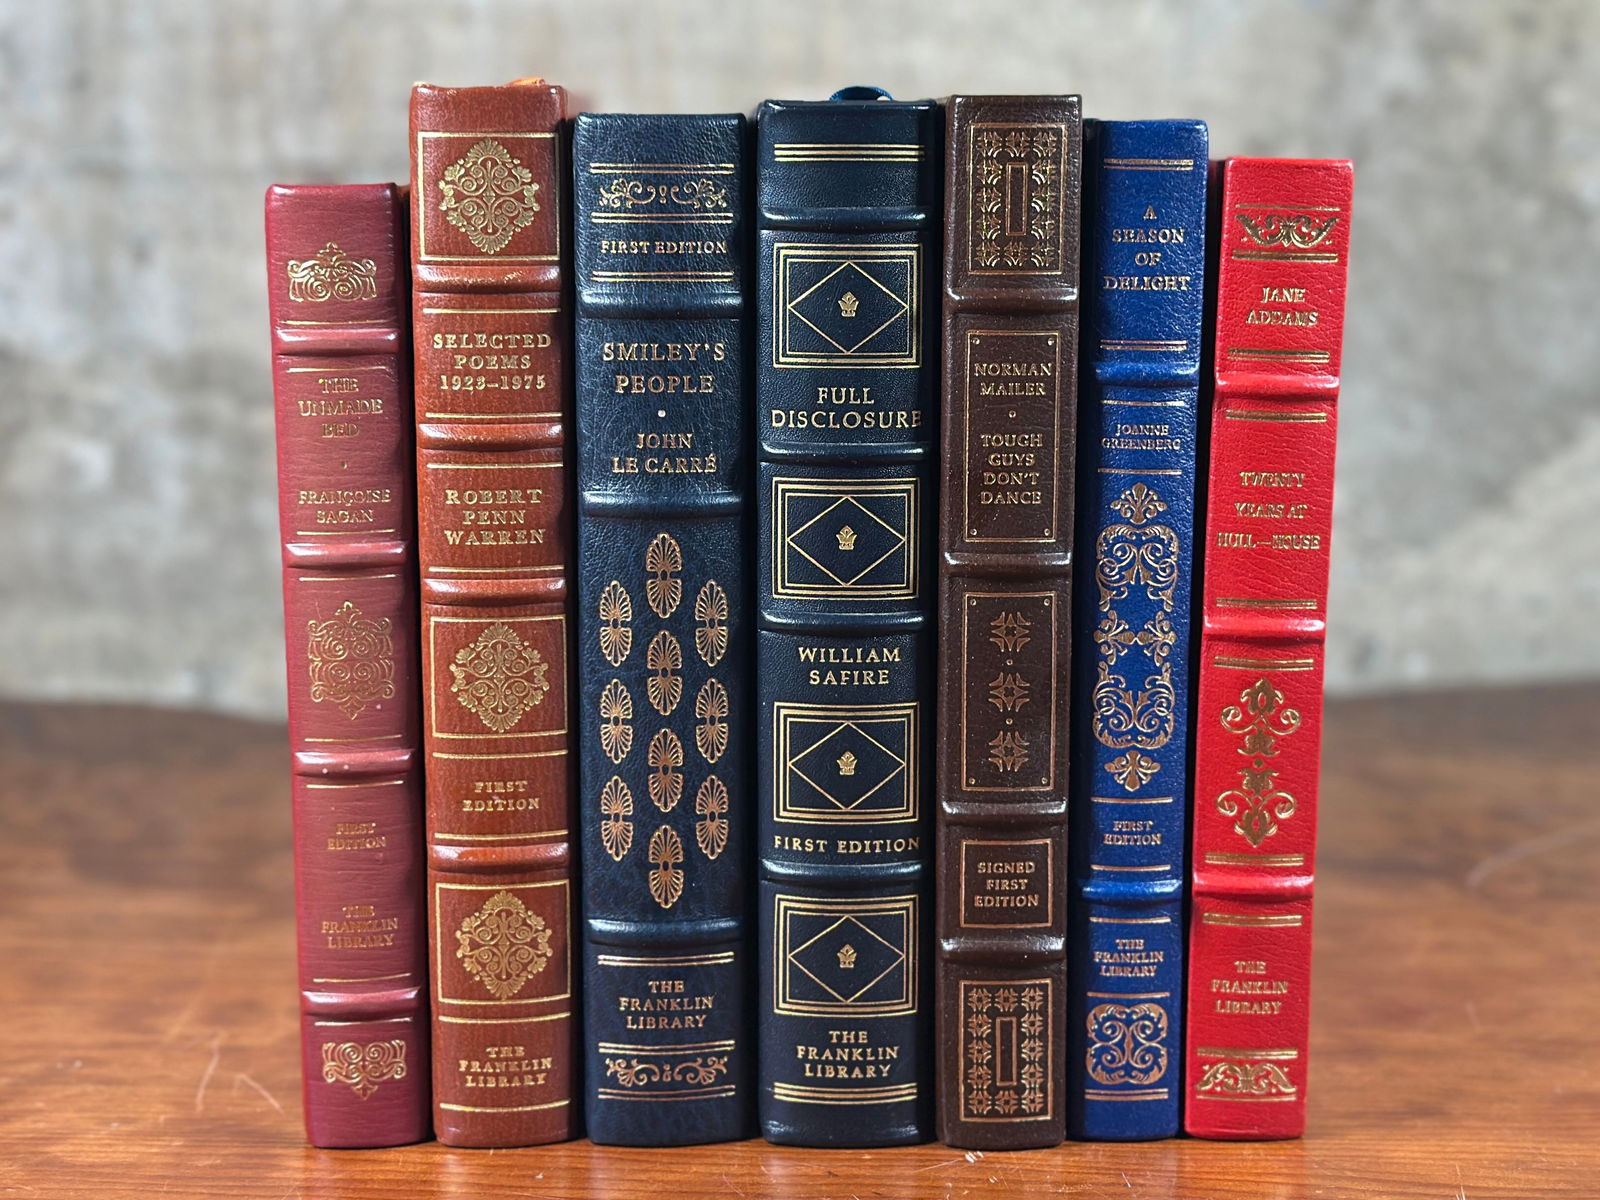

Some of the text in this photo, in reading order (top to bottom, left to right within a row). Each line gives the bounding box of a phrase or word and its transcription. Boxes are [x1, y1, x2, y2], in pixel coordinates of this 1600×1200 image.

[1143, 205, 1158, 220] A
[1111, 228, 1185, 244] SEASON
[600, 240, 727, 254] FIRST EDITION
[1135, 252, 1162, 266] OF
[1103, 276, 1191, 291] DELIGHT
[1260, 287, 1306, 303] JANE
[1245, 309, 1319, 327] ADDAMS
[433, 333, 551, 349] SELECTED
[602, 342, 726, 361] SMILEY'S
[454, 355, 532, 370] POEMS
[974, 363, 1052, 376] NORMAN
[318, 377, 359, 394] THE
[615, 375, 715, 394] PEOPLE
[980, 383, 1046, 396] MAILER
[816, 387, 875, 404] FULL
[298, 398, 384, 416] UNMADE
[771, 409, 922, 428] DISCLOSURE
[321, 422, 360, 438] BED
[1115, 424, 1169, 436] JOANNE
[636, 433, 693, 449] JOHN
[980, 434, 1043, 447] TOUGH
[1101, 438, 1182, 450] GREENBERG
[611, 453, 718, 474] LE CARRÉ
[988, 453, 1036, 466] GUYS
[983, 472, 1040, 485] DON'T
[1239, 471, 1306, 488] TWENTY
[298, 489, 392, 506] FRANÇOISE
[445, 489, 543, 505] ROBERT
[980, 491, 1042, 504] DANCE
[316, 509, 374, 524] SAGAN
[462, 510, 526, 525] PENN
[1234, 502, 1308, 519] YEARS AT
[444, 529, 546, 545] WARREN
[798, 646, 901, 663] WILLIAM
[809, 670, 889, 685] SAFIRE
[474, 780, 528, 793] FIRST
[462, 798, 540, 812] EDITION
[336, 822, 376, 835] FIRST
[1113, 820, 1153, 832] FIRST
[327, 836, 386, 850] EDITION
[774, 835, 920, 853] FIRST EDITION
[1103, 833, 1162, 846] EDITION
[977, 861, 1036, 874] SIGNED
[986, 879, 1028, 890] FIRST
[974, 894, 1040, 907] EDITION
[321, 918, 398, 933] FRANKLIN
[327, 934, 394, 949] LIBRARY
[1115, 938, 1145, 950] THE
[1093, 951, 1164, 963] FRANKLIN
[1099, 965, 1157, 977] LIBRARY
[1234, 961, 1267, 974] THE
[648, 980, 685, 993] THE
[1210, 978, 1289, 995] FRANKLIN
[618, 995, 715, 1011] FRANKLIN
[1215, 999, 1282, 1015] LIBRARY
[626, 1014, 707, 1029] LIBRARY
[828, 1031, 868, 1043] THE
[486, 1046, 525, 1058] THE
[796, 1045, 899, 1061] FRANKLIN
[458, 1057, 553, 1073] FRANKLIN
[804, 1063, 891, 1078] LIBRARY
[465, 1073, 547, 1087] LIBRARY
